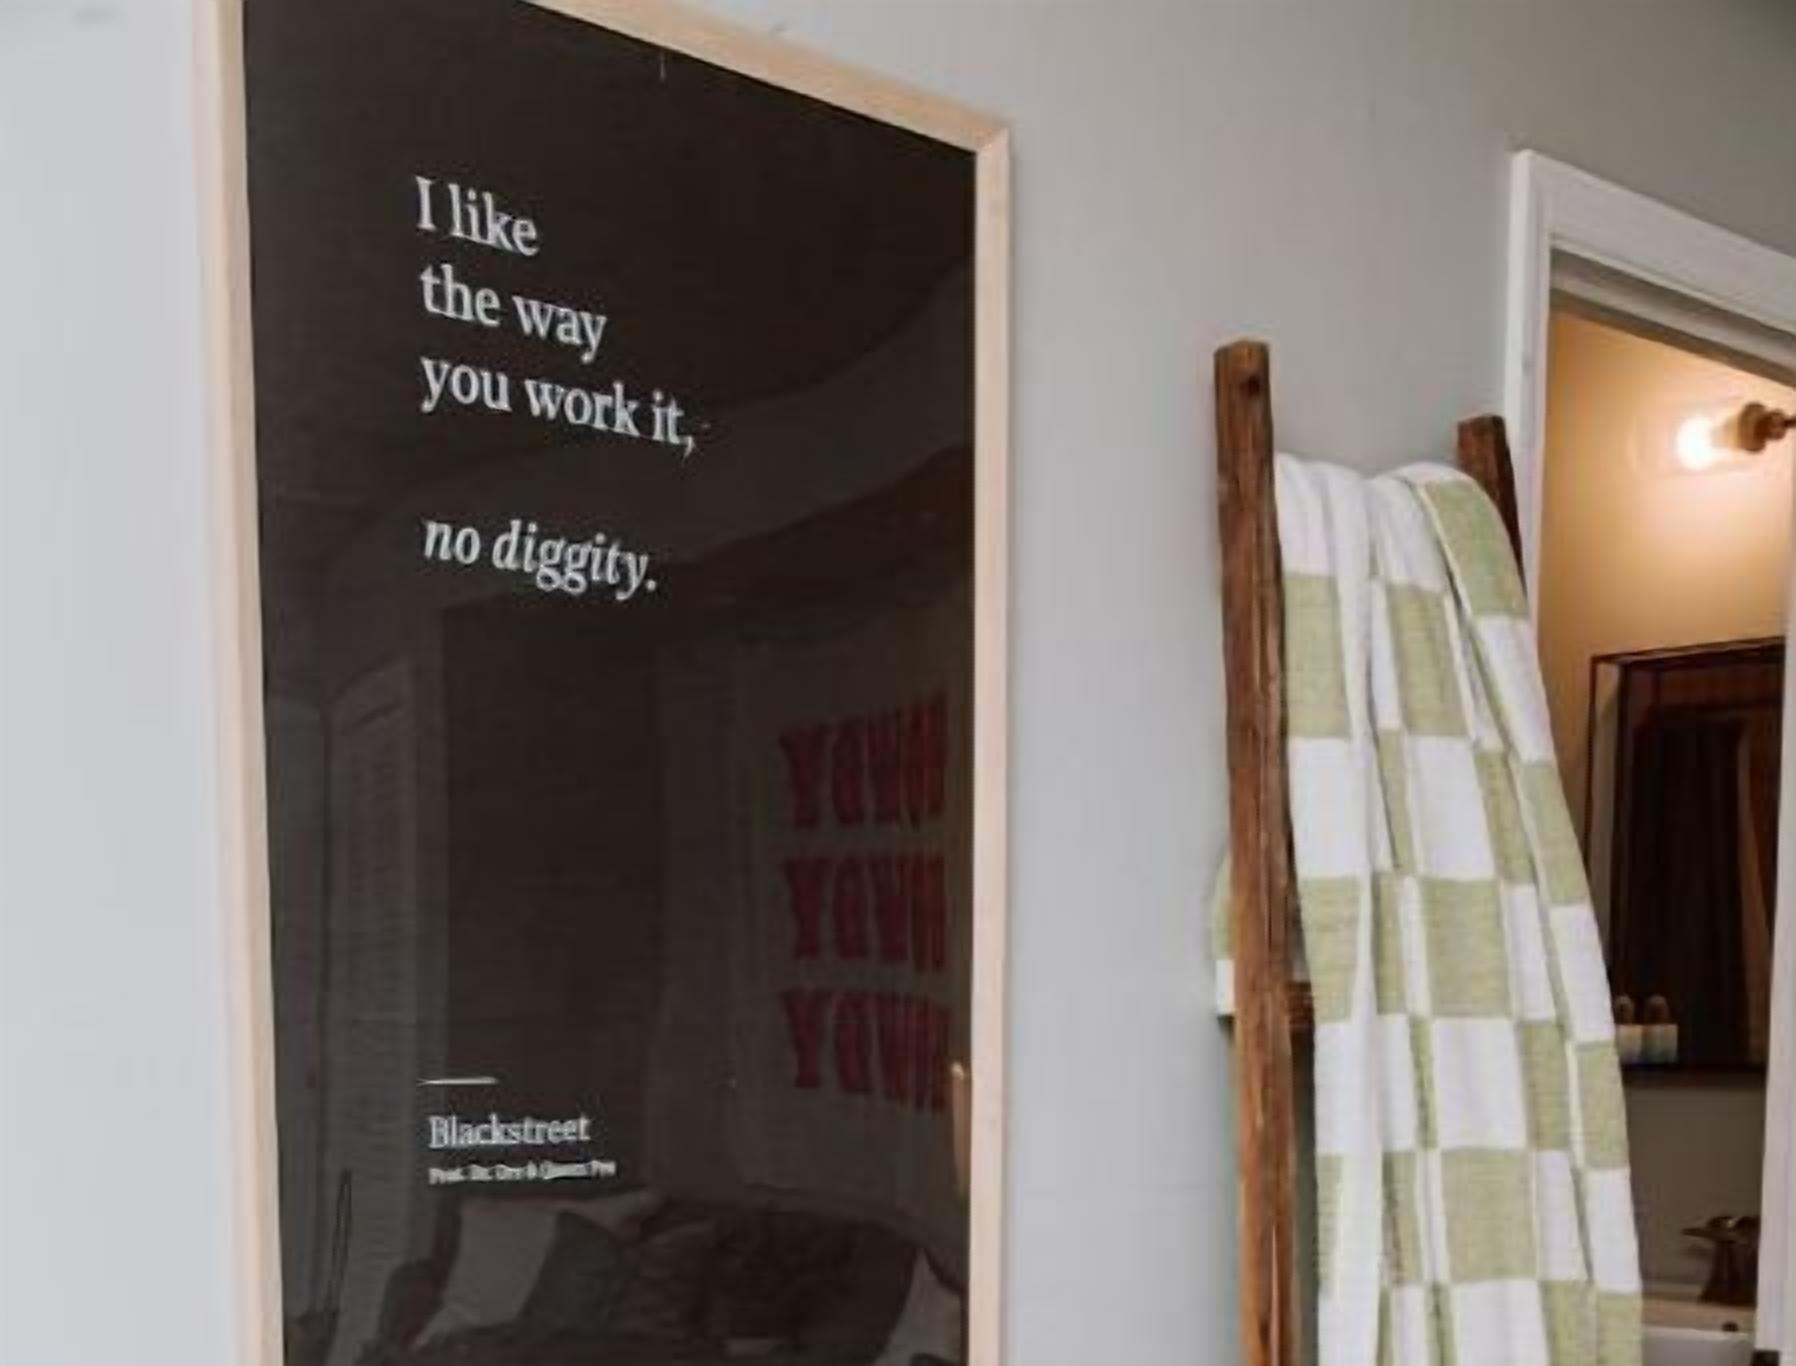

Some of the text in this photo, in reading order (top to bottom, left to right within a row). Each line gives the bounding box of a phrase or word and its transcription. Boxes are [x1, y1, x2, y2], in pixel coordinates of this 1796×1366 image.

[415, 175, 538, 256] I like
[419, 263, 607, 364] the way
[420, 356, 695, 458] you work it,
[424, 518, 657, 601] no diggity.
[428, 1112, 591, 1149] Blackstreet
